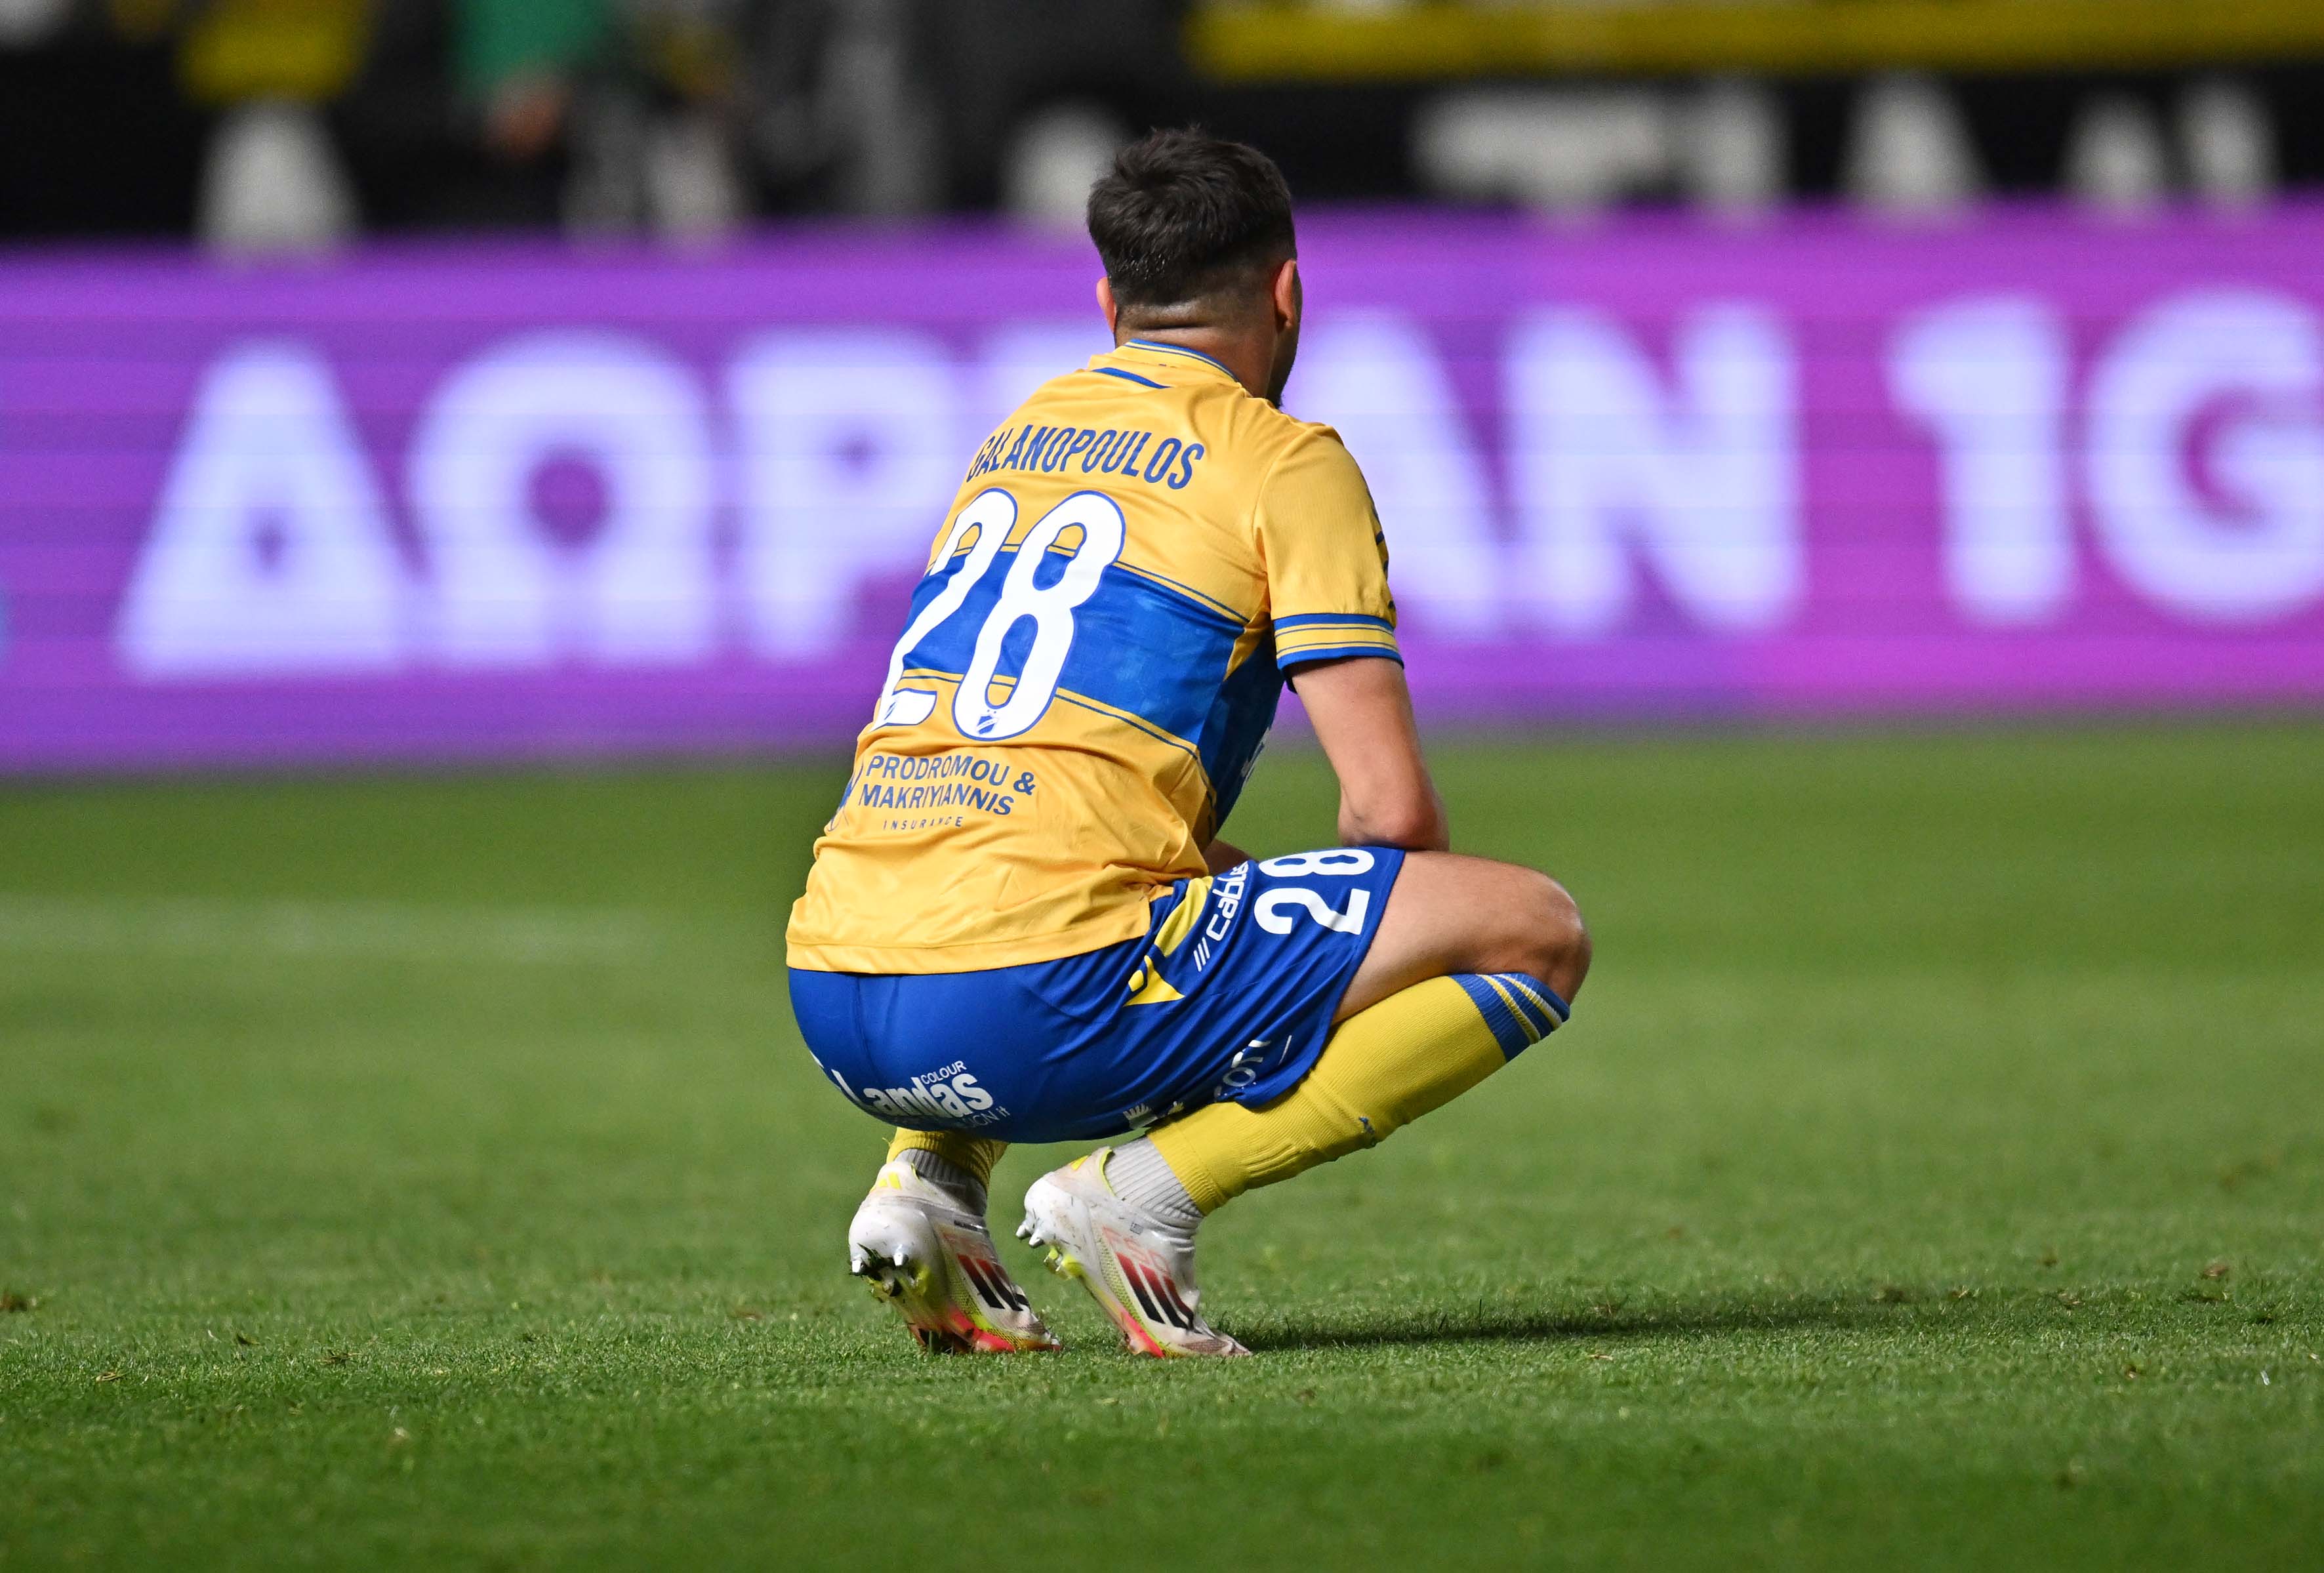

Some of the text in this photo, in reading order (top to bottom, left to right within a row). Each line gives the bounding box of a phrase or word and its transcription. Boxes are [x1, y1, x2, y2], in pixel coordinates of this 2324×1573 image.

[966, 424, 1205, 490] GALANOPOULOS
[871, 487, 1126, 741] 28
[866, 754, 1036, 796] PRODROMOU &
[1254, 849, 1375, 935] 28
[920, 1060, 967, 1085] COLOUR
